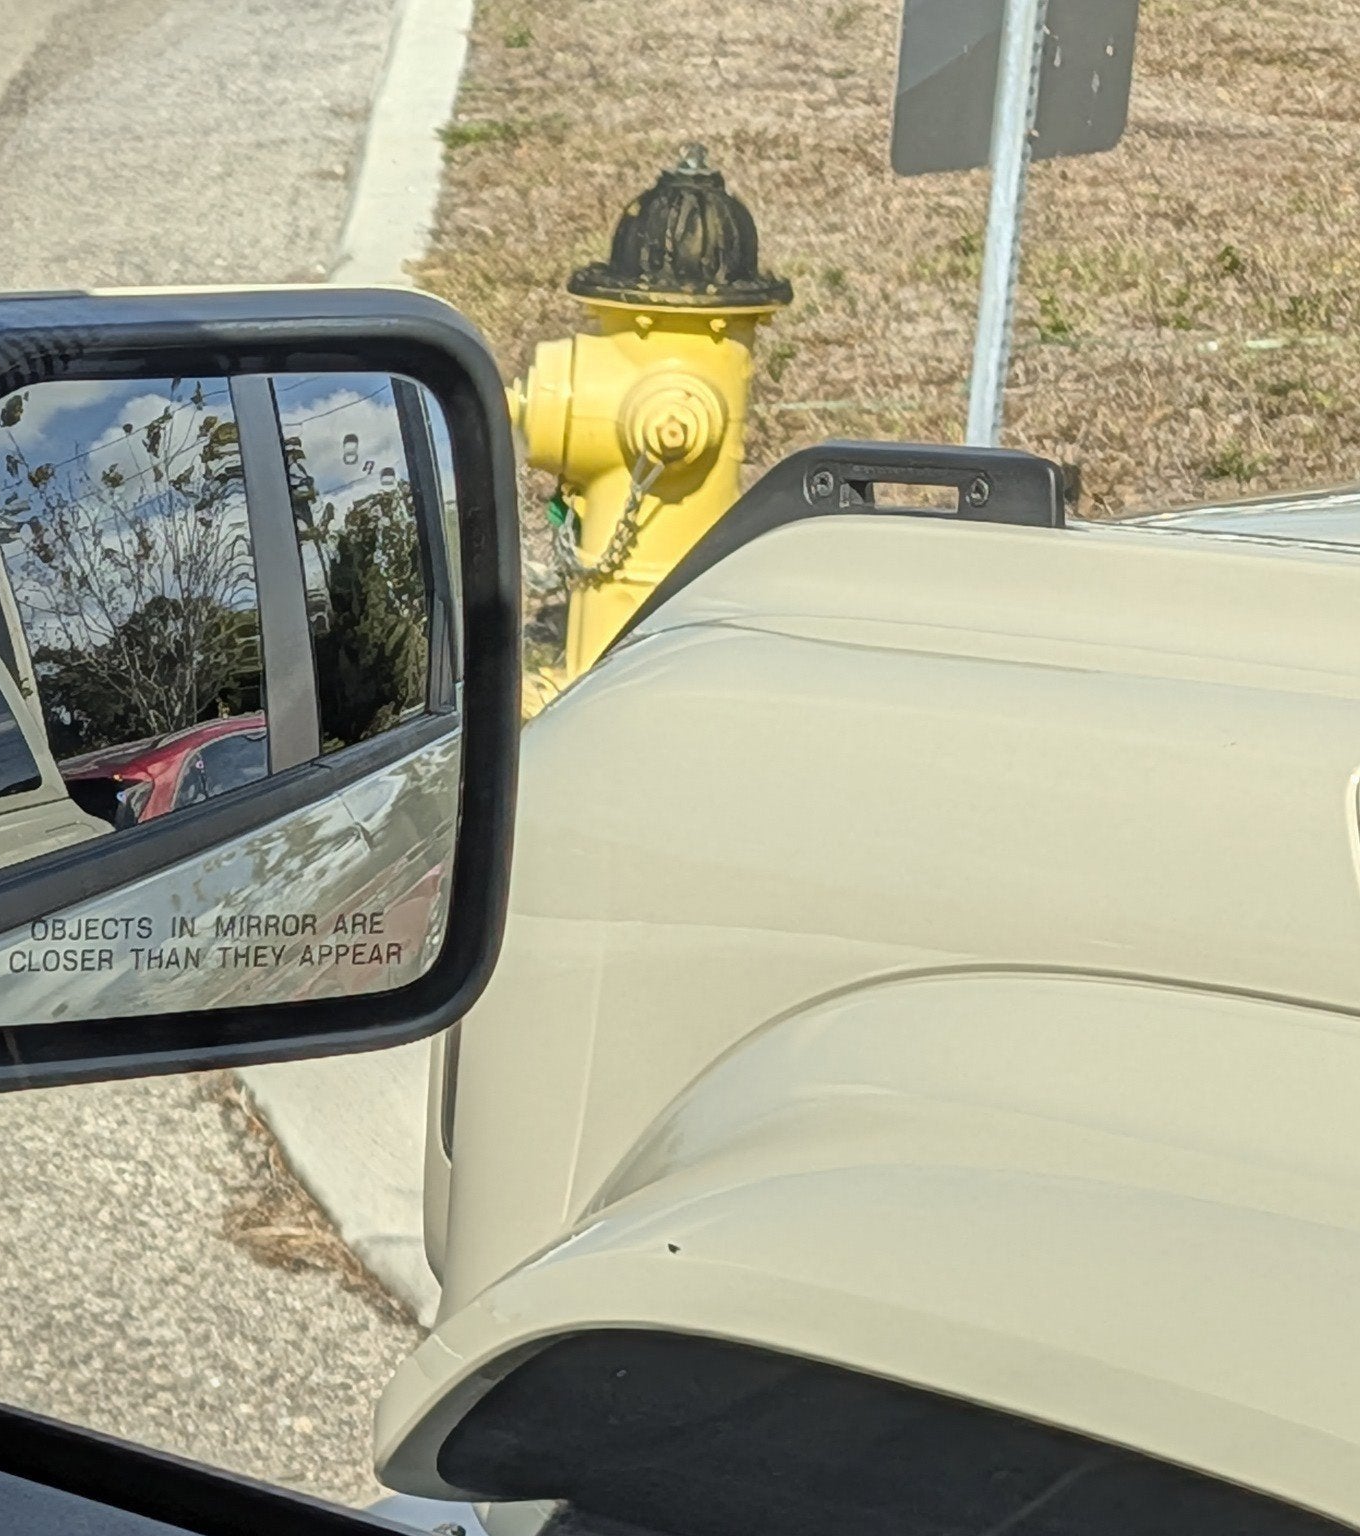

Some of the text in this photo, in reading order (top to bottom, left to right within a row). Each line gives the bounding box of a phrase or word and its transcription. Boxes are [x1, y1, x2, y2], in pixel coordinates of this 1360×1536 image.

[30, 910, 385, 942] OBJECTS IN MIRROR ARE
[8, 941, 403, 974] CLOSER THAN THEY APPEAR
